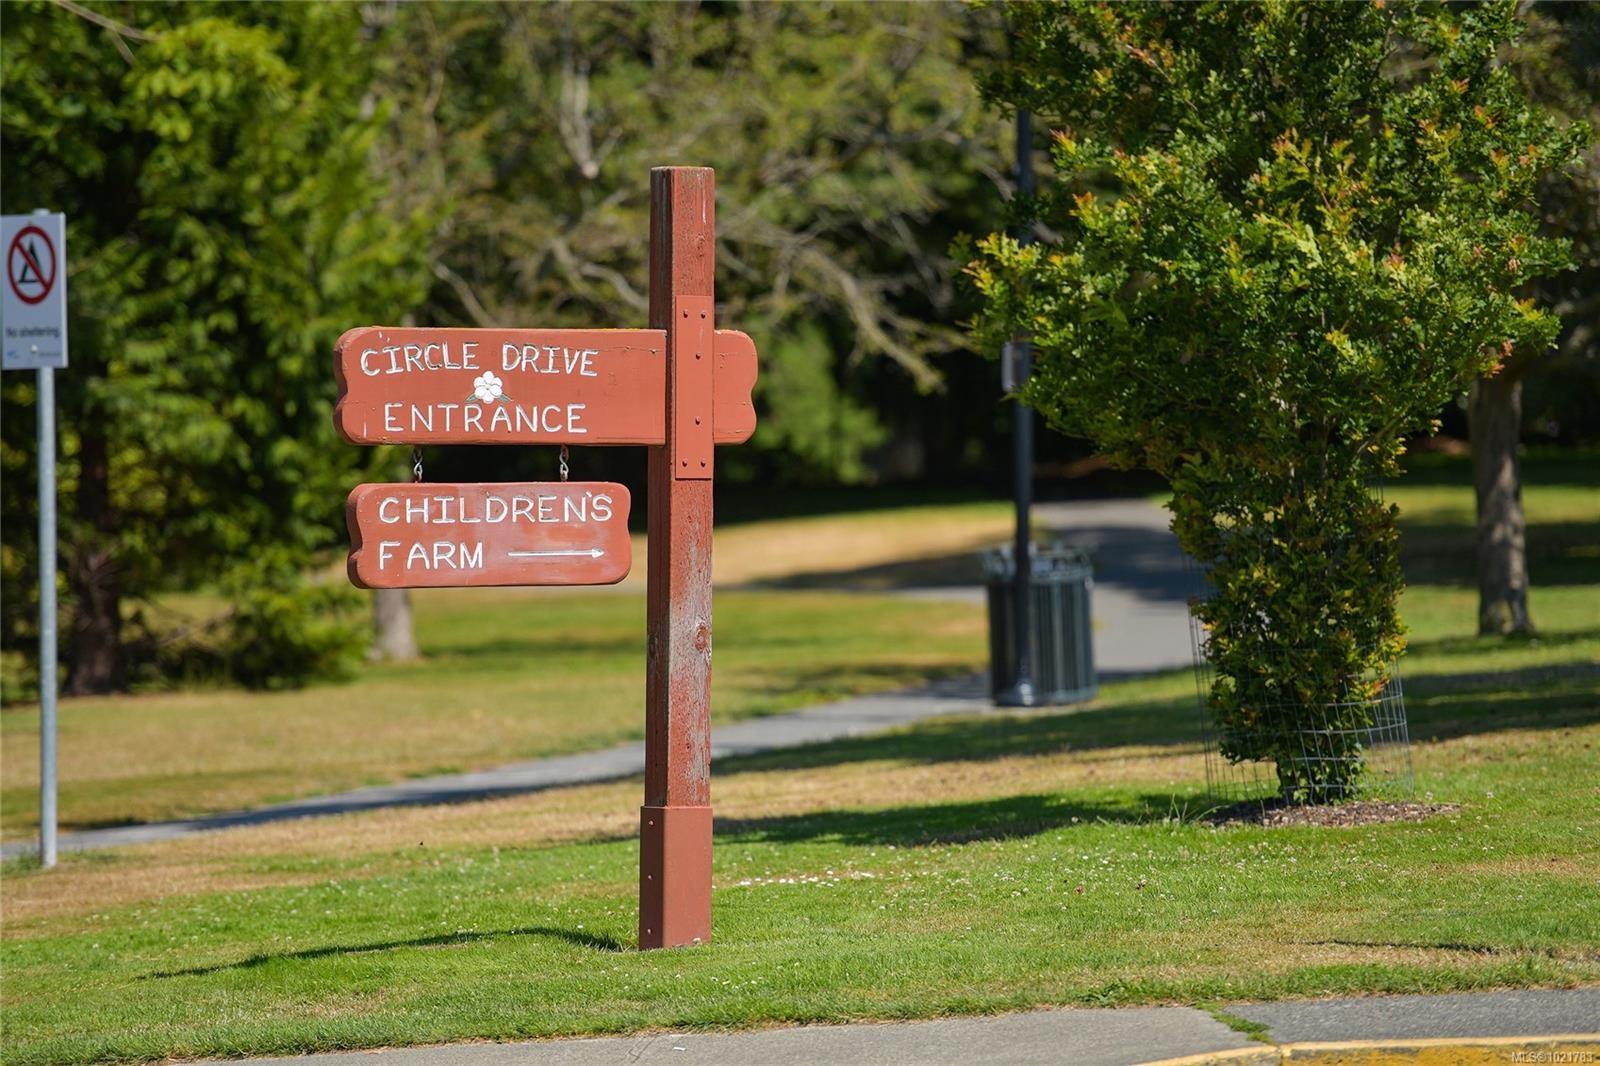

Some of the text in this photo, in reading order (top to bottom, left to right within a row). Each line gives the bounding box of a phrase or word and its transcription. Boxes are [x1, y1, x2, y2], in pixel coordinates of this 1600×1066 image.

[360, 341, 599, 377] CIRCLE DRIVE
[384, 402, 588, 433] ENTRANCE
[378, 491, 613, 524] CHILDREN'S
[379, 540, 483, 570] FARM
